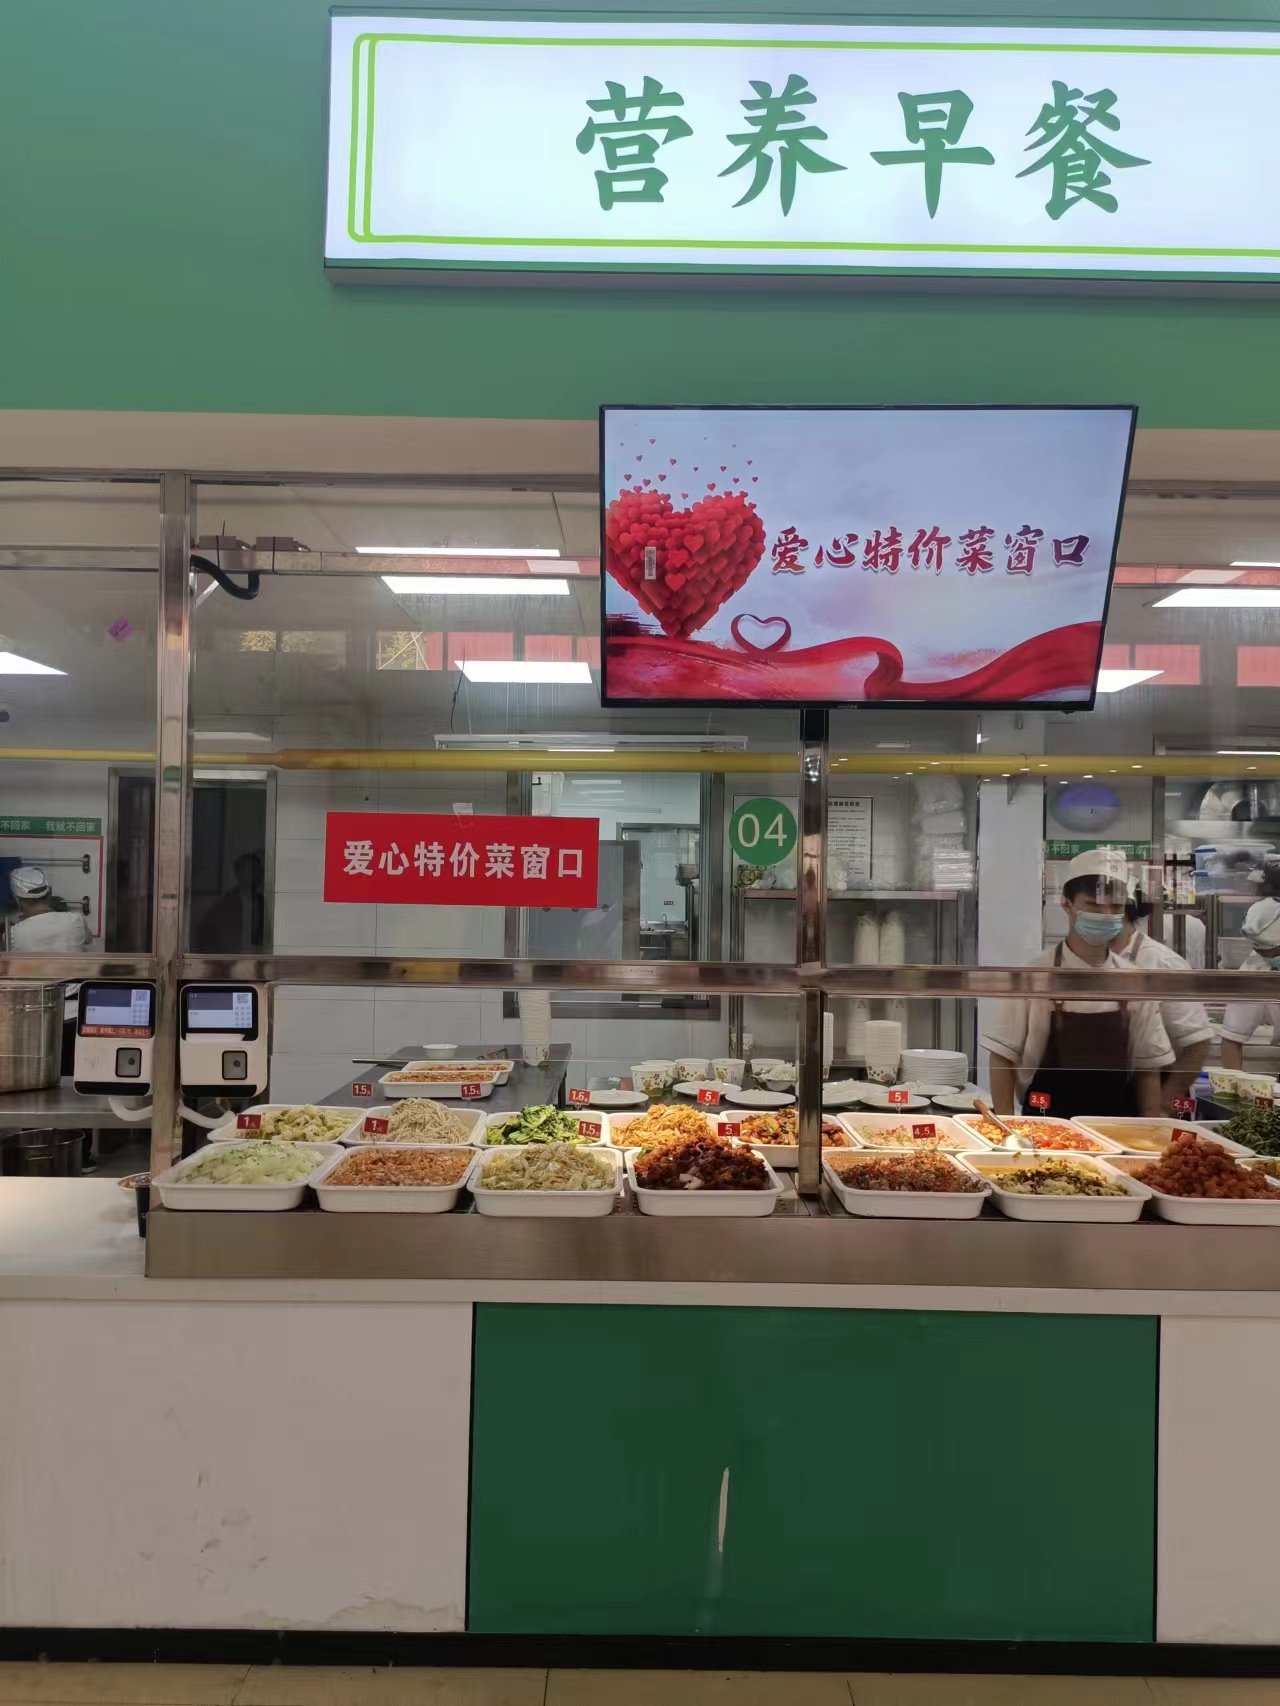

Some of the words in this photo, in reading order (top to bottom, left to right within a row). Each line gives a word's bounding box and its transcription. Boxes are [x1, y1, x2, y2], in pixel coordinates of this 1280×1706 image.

[576, 74, 1152, 220] 营养早餐
[771, 524, 1090, 574] 爱心特价菜窗口
[738, 813, 788, 848] 04
[343, 840, 583, 880] 爱心特价菜窗口
